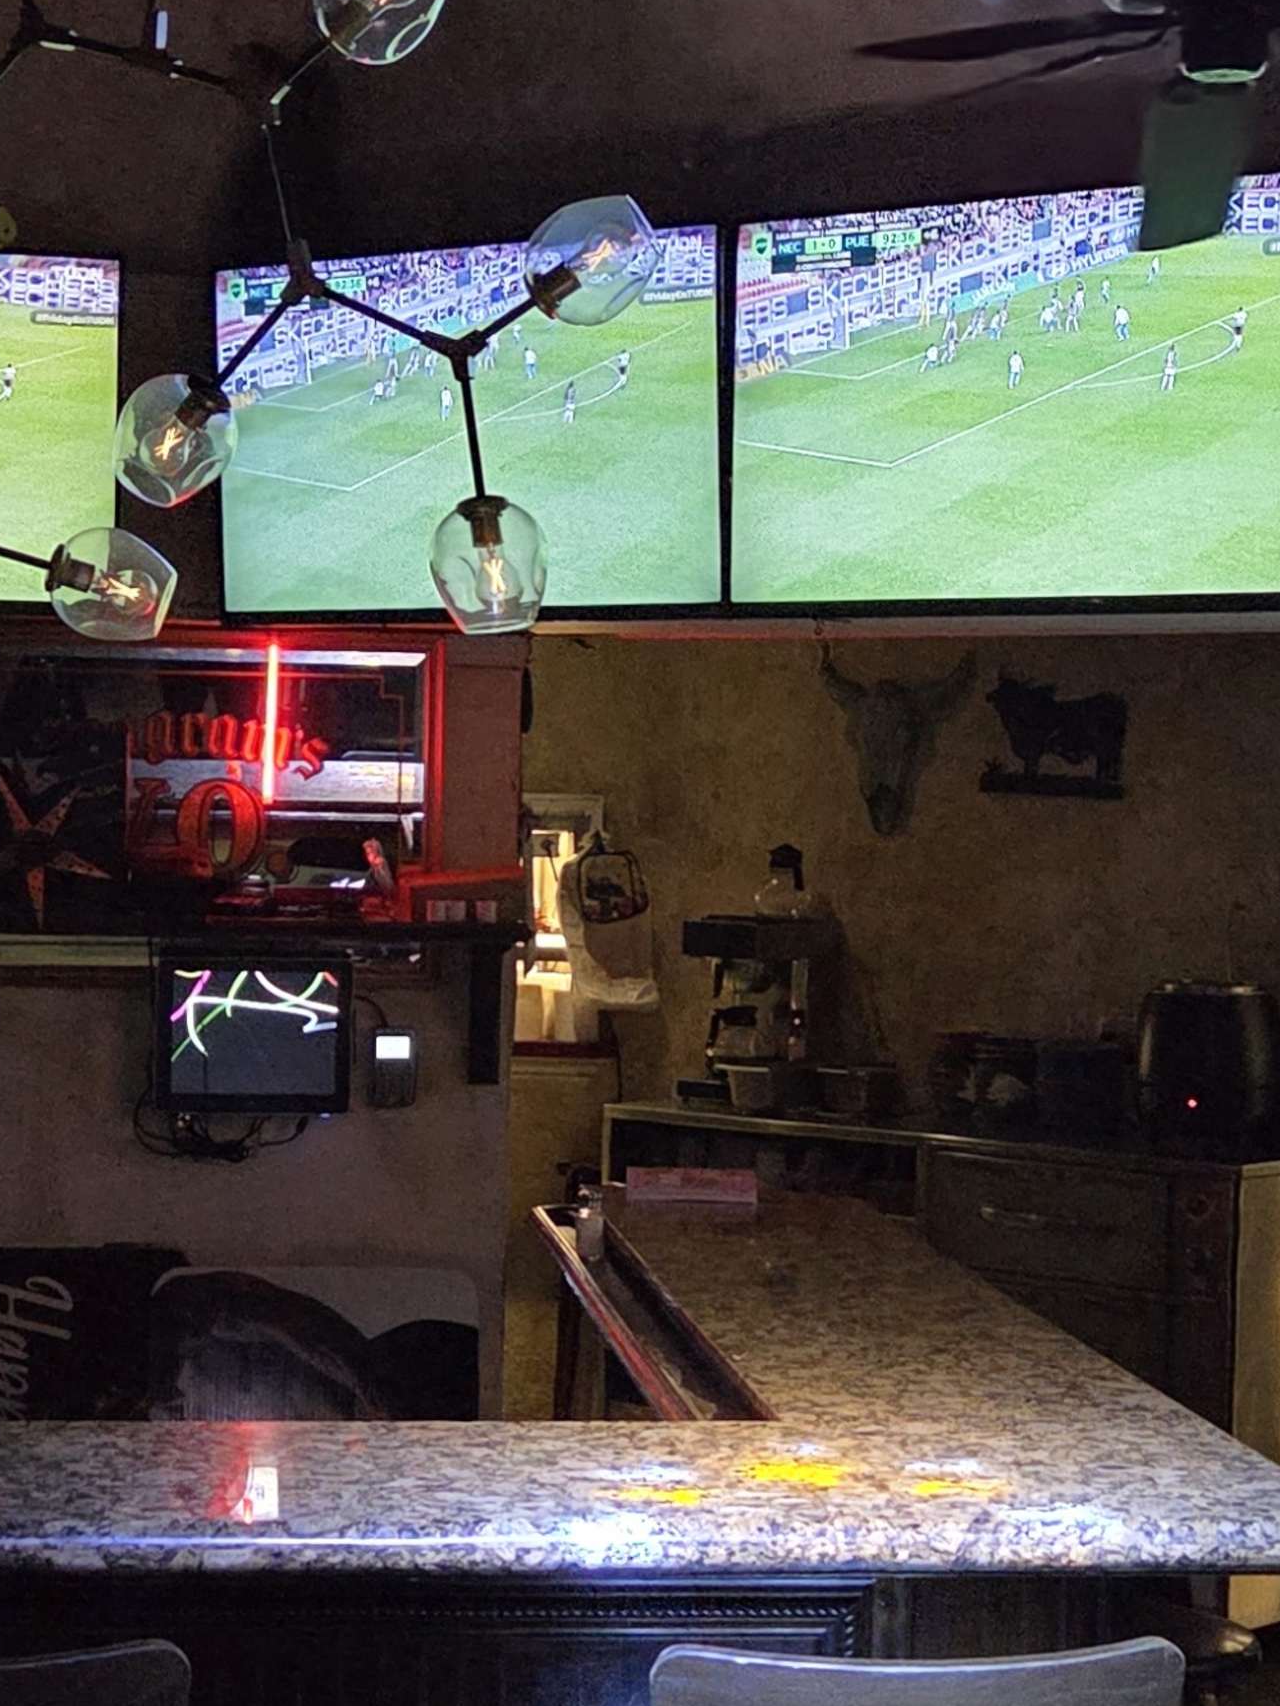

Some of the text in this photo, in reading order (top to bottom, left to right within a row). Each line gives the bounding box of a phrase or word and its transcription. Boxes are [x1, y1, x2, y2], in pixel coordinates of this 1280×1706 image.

[779, 241, 803, 255] NEC
[846, 234, 870, 248] PUE
[882, 231, 917, 244] 92:36
[808, 261, 920, 307] SKECHERS
